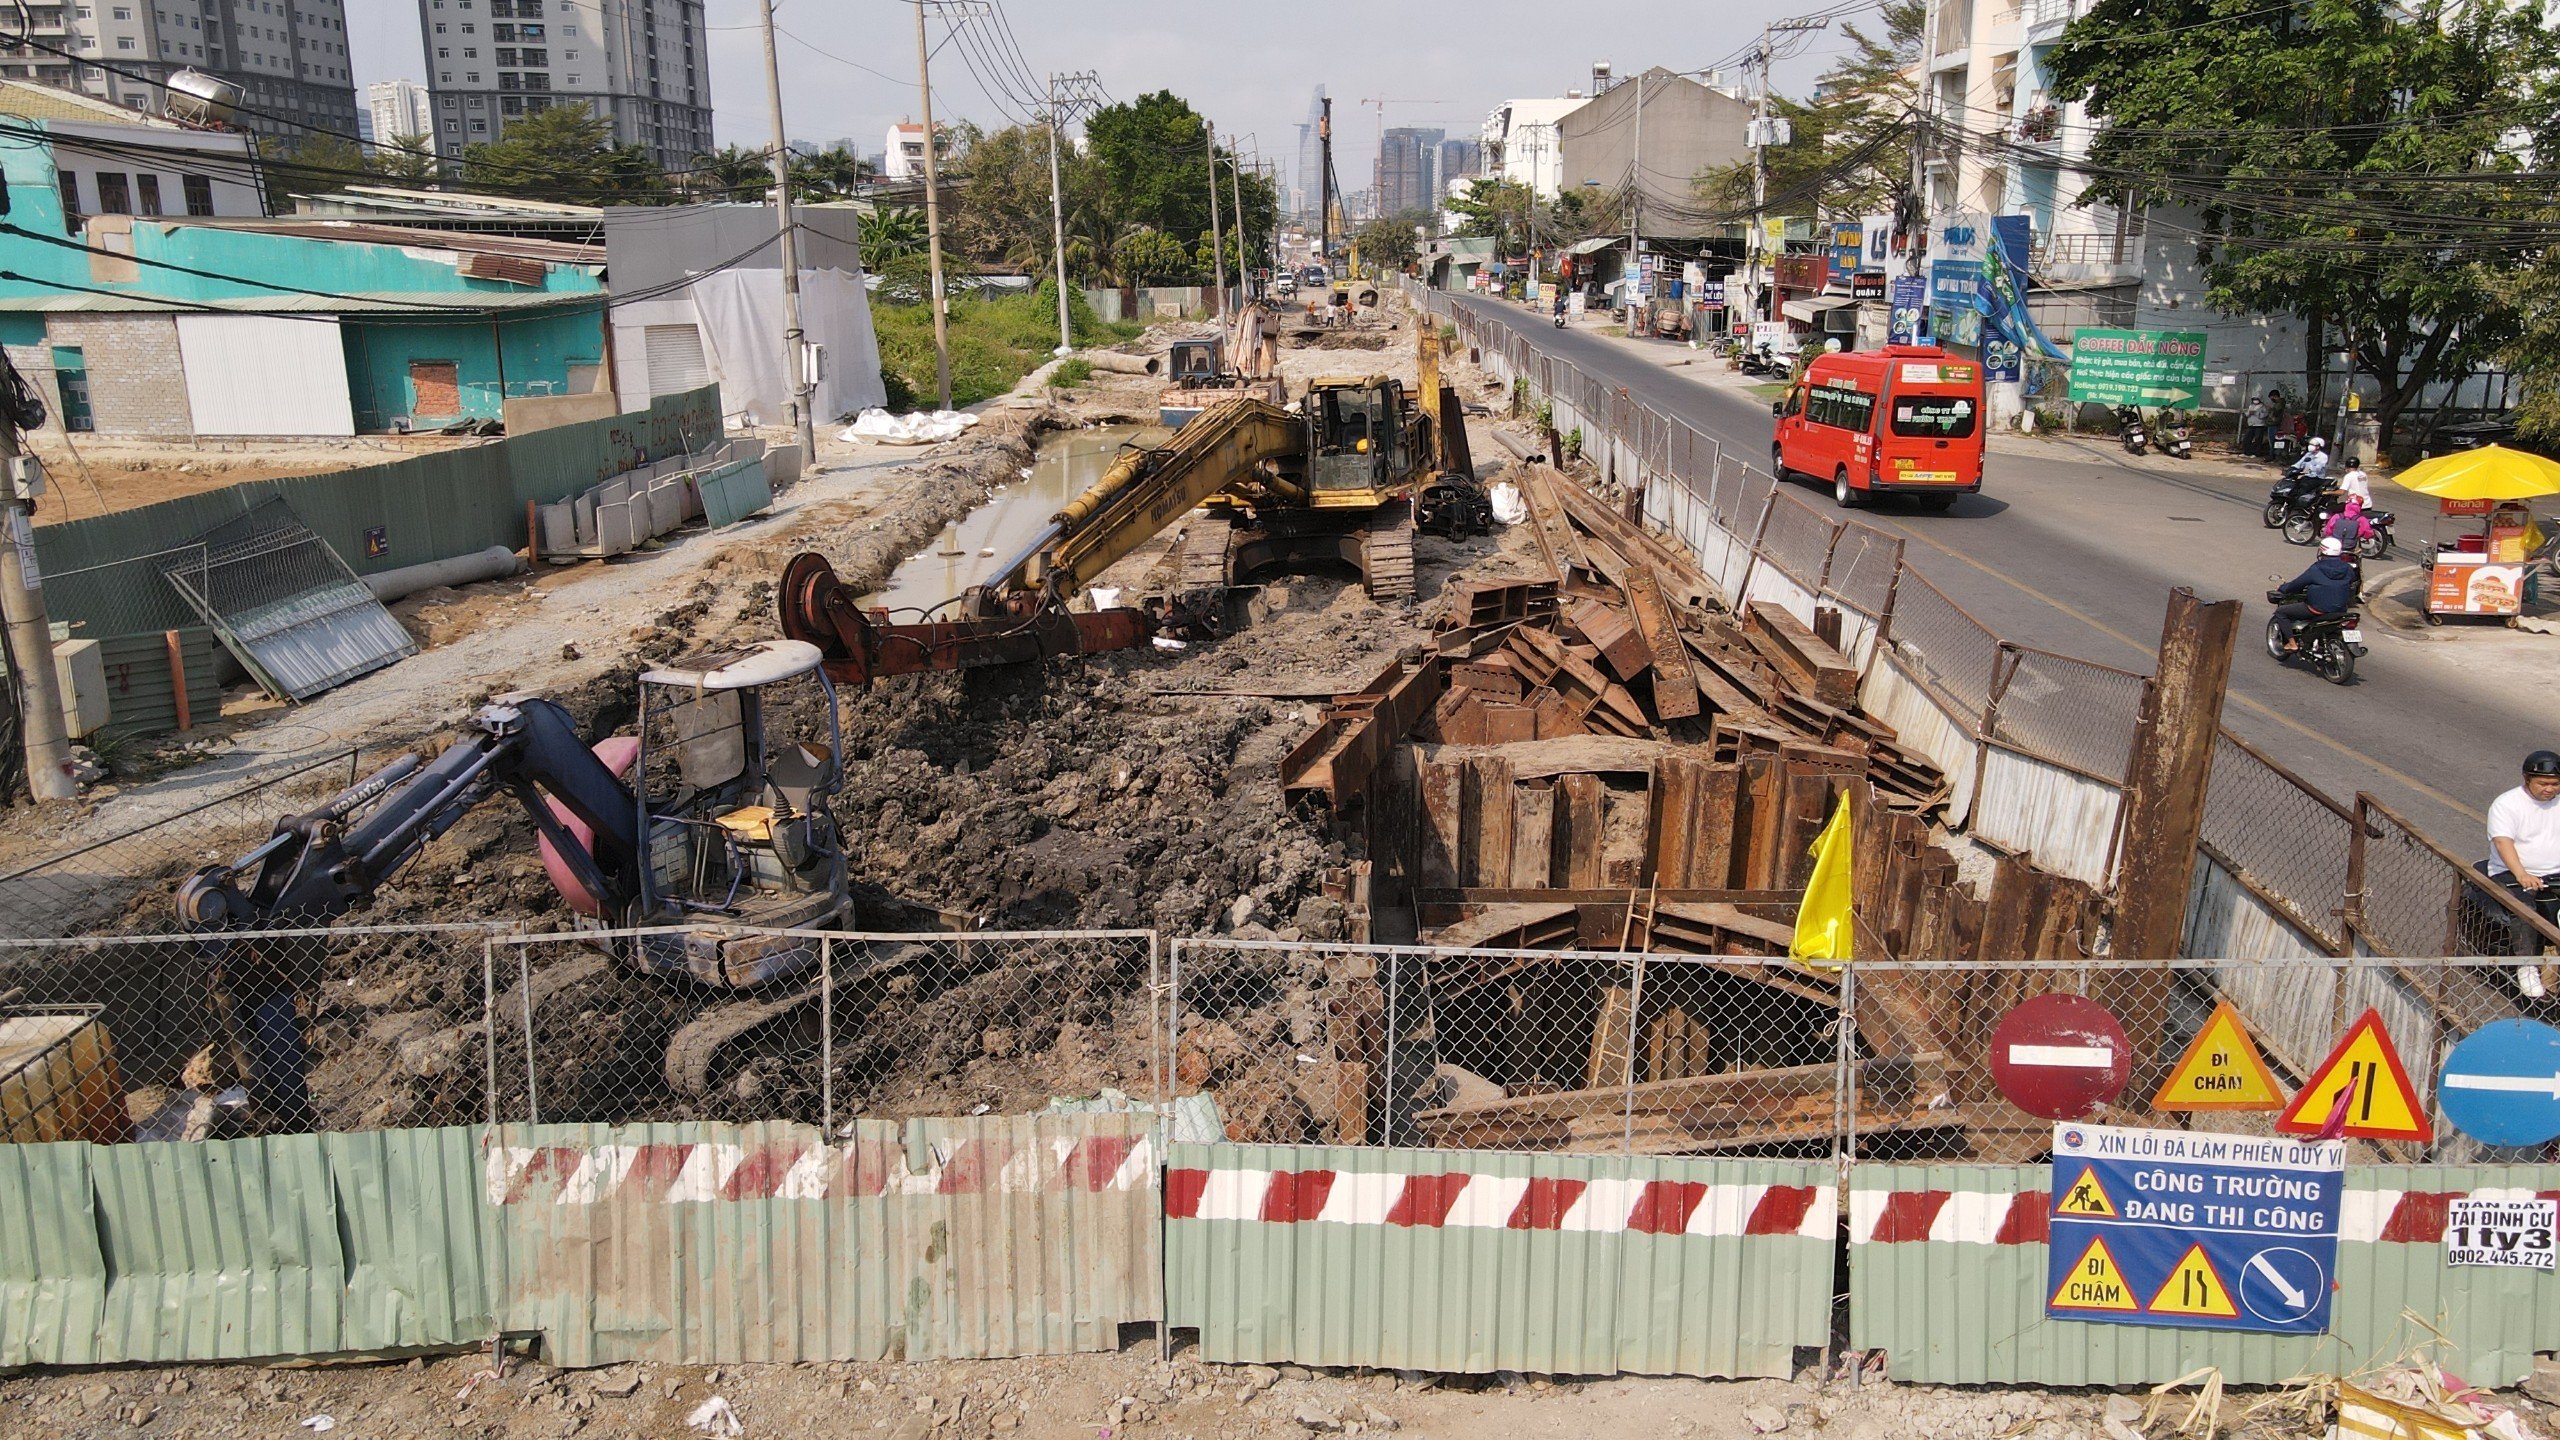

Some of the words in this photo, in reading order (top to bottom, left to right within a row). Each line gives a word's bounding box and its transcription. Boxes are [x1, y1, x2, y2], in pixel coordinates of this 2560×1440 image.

[2078, 337, 2124, 353] COFFEE
[2158, 337, 2200, 356] NÔNG
[2181, 374, 2196, 385] bạn
[331, 778, 387, 816] KOMATSU
[2211, 1053, 2228, 1067] ĐI
[2193, 1073, 2242, 1093] CHẬM
[2099, 1134, 2126, 1154] XIN
[2132, 1131, 2158, 1156] LỖI
[2164, 1136, 2185, 1158] ĐÃ
[2191, 1138, 2226, 1160] LÀM
[2232, 1139, 2283, 1164] PHIỀN
[2289, 1145, 2323, 1166] QUÝ
[2328, 1148, 2342, 1170] VỊ
[2134, 1169, 2203, 1194] CÔNG
[2212, 1174, 2320, 1201] TRƯỜNG
[2125, 1200, 2194, 1223] ĐANG
[2203, 1204, 2244, 1226] THI
[2253, 1206, 2324, 1230] CÔNG
[2529, 1211, 2554, 1227] CƯ
[2087, 1258, 2104, 1276] ĐI
[2449, 1249, 2553, 1267] 0902.445.272
[2070, 1280, 2119, 1305] CHẬM
